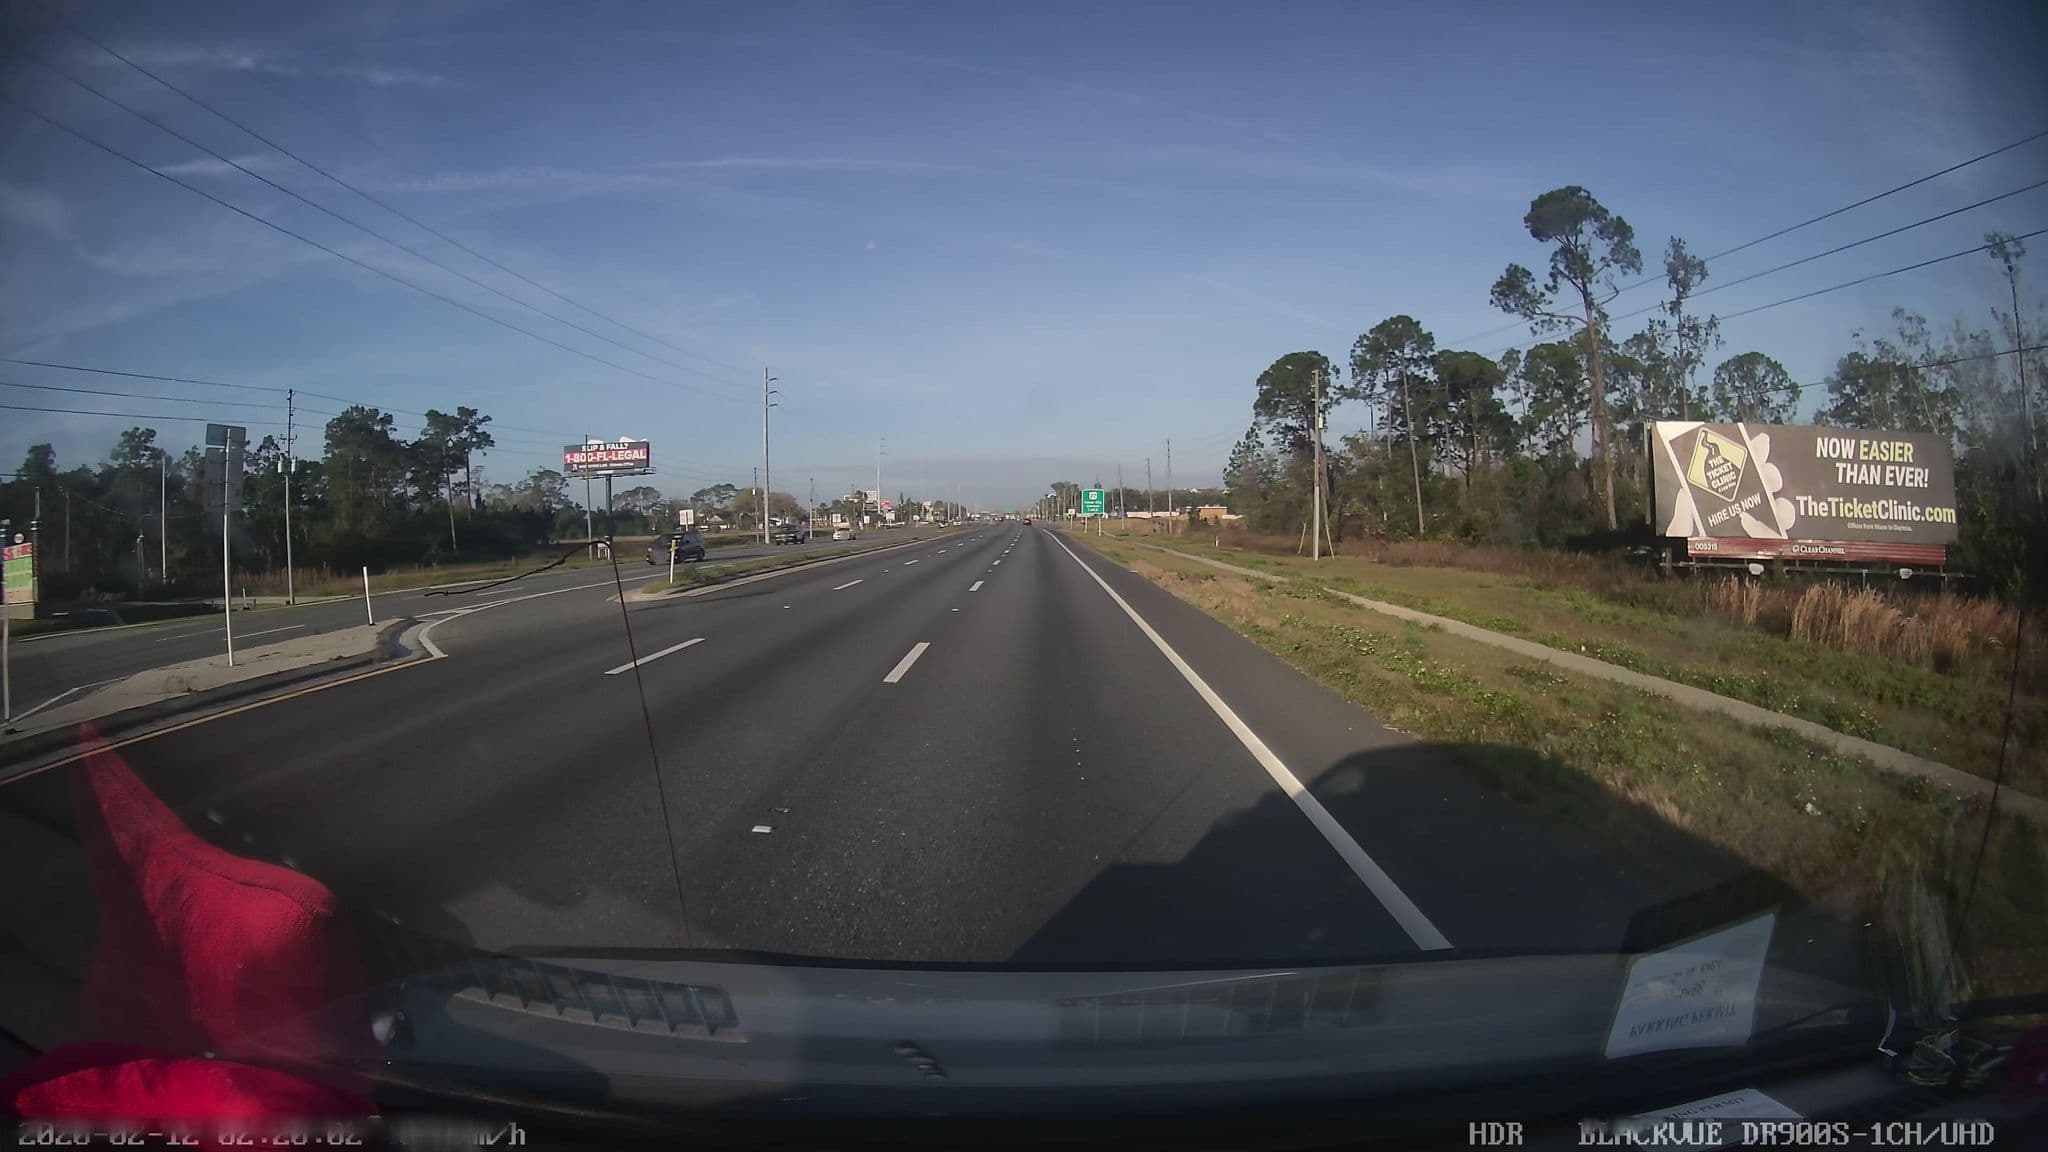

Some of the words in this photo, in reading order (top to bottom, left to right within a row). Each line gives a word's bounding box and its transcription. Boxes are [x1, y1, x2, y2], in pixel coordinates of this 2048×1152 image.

[565, 448, 647, 463] 1-800-FL-LEGAL
[581, 444, 598, 452] SLIP
[1816, 437, 1856, 459] NOW
[1860, 439, 1914, 463] EASIER
[1707, 462, 1733, 480] TICKET
[1708, 456, 1725, 468] THE
[1711, 472, 1737, 489] CLINIC
[1835, 462, 1881, 485] THAN
[1885, 465, 1929, 488] EVER!
[1707, 509, 1730, 527] HIRE
[1728, 503, 1742, 517] US
[1740, 493, 1762, 511] NOW
[1796, 495, 1957, 524] TheTicketClinic.com
